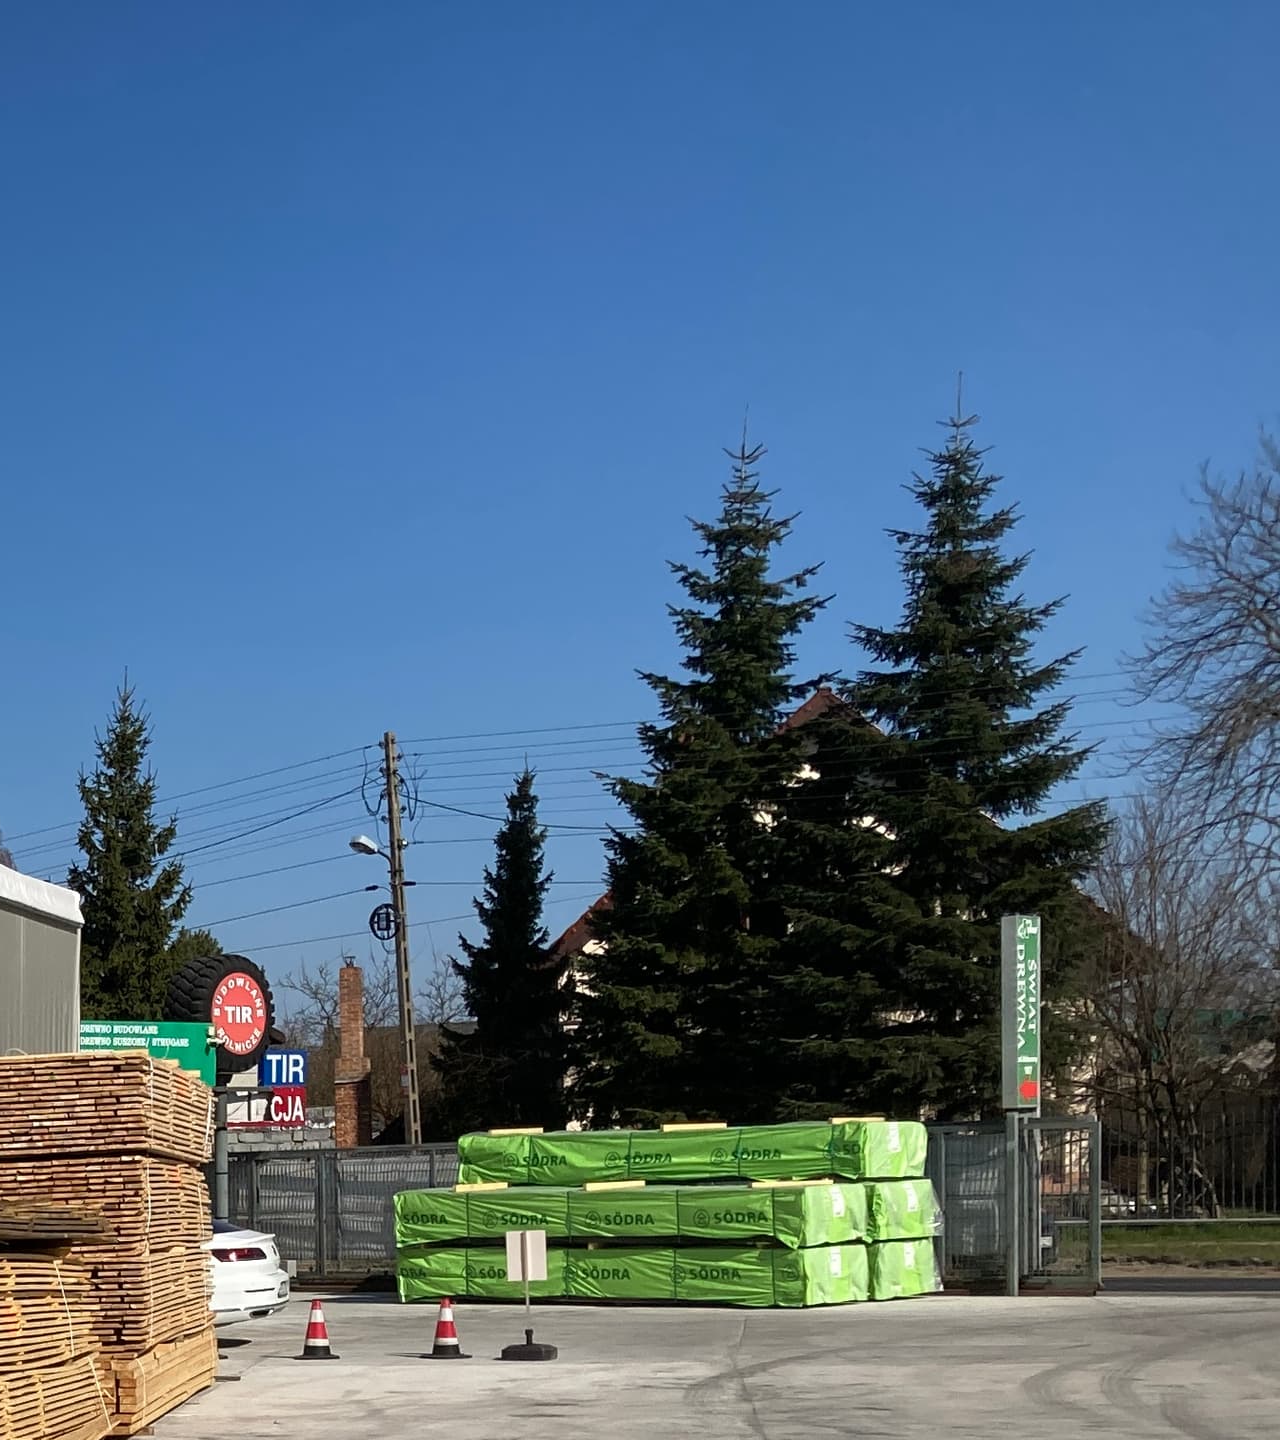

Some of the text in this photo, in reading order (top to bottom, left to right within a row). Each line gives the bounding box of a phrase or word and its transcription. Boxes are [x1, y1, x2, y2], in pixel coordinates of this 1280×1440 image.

[213, 977, 264, 1017] BUDOWLANE
[1016, 944, 1026, 1049] DREWNA
[224, 1005, 253, 1024] TIR
[217, 1027, 262, 1051] ROLNICZE
[266, 1054, 304, 1083] TIR
[403, 1213, 449, 1225] SÖDRA
[501, 1213, 549, 1226] SÖDRA
[605, 1212, 655, 1226] SÖDRA
[714, 1208, 769, 1225] SÖDRA
[581, 1267, 630, 1280] SÖDRA
[690, 1267, 740, 1280] SÖDRA
